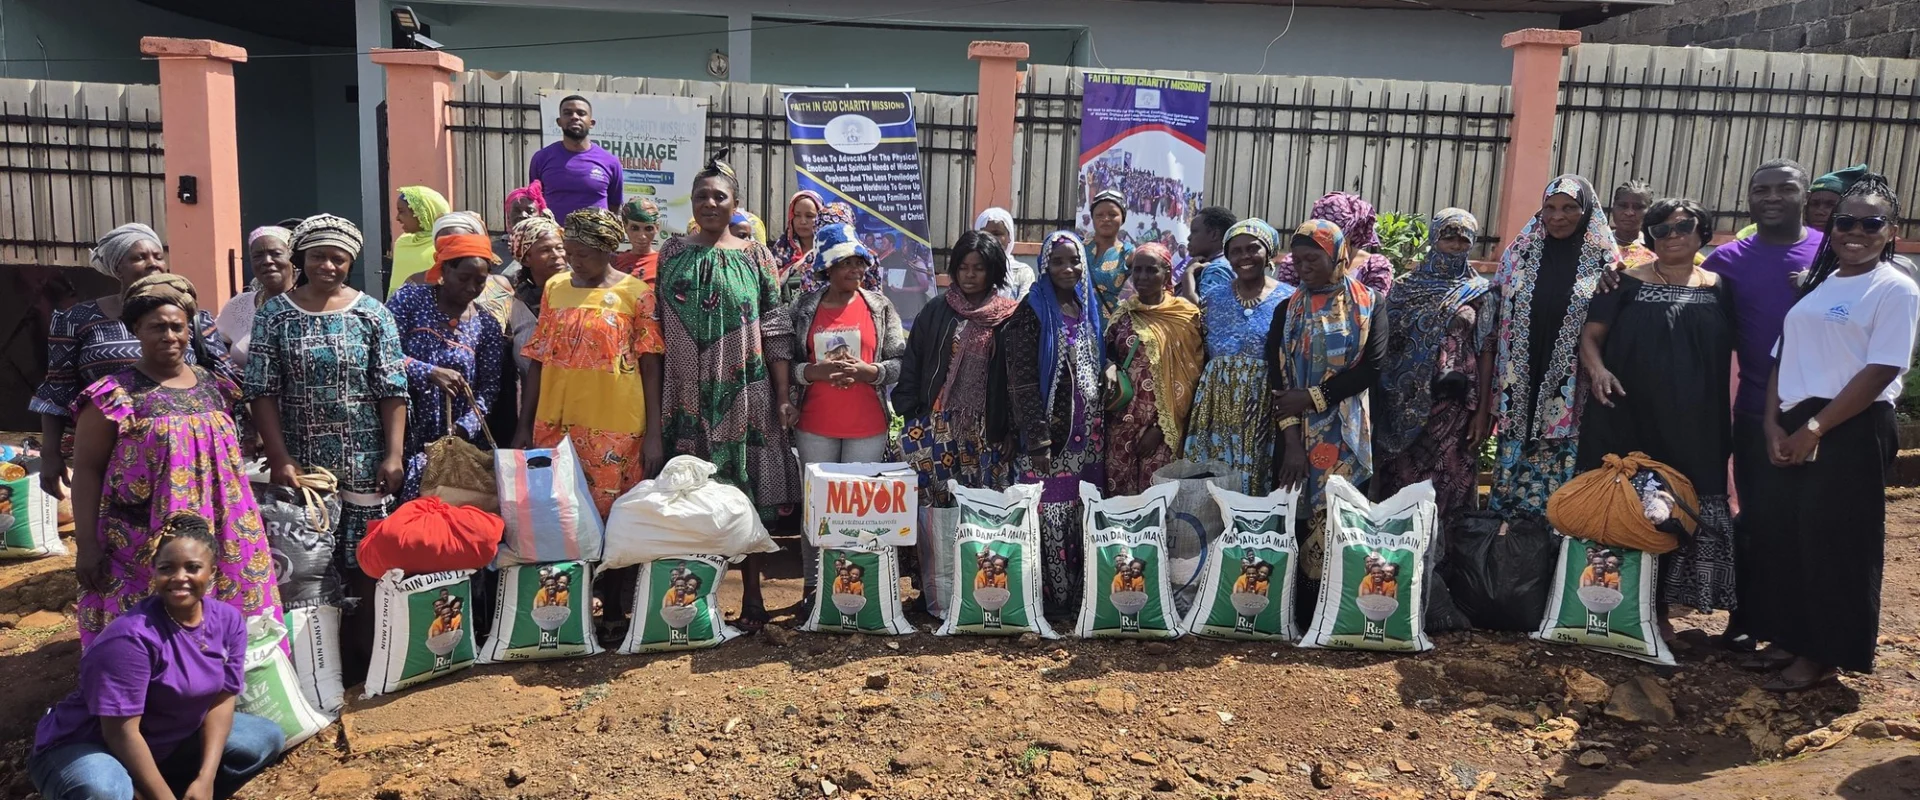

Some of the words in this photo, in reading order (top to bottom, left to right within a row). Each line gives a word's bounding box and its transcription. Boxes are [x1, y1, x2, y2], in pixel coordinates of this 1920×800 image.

[1088, 74, 1110, 83] FAITH
[1112, 75, 1120, 84] IN
[1122, 76, 1136, 86] GOD
[1137, 76, 1169, 88] CHARITY
[1171, 80, 1206, 92] MISSIONS
[790, 102, 811, 112] FAITH
[813, 101, 820, 111] IN
[822, 100, 837, 112] GOD
[839, 100, 870, 112] CHARITY
[871, 101, 905, 111] MISSIONS
[591, 139, 677, 161] PHANAGE
[838, 154, 867, 162] Advocate
[892, 153, 917, 162] Physical
[621, 157, 662, 169] HELINAT
[848, 164, 871, 173] Spiritual
[825, 174, 849, 184] Orphans
[874, 173, 887, 182] Less
[840, 184, 862, 192] Children
[912, 183, 920, 191] Up
[868, 194, 886, 202] Loving
[878, 204, 894, 212] Know
[1262, 535, 1271, 544] LA
[1336, 531, 1357, 544] MAIN
[1384, 537, 1395, 547] LA
[1398, 536, 1420, 549] MAIN
[426, 571, 452, 584] DANS
[313, 615, 319, 624] LA
[382, 619, 387, 627] LA
[1589, 614, 1607, 628] Riz
[1366, 621, 1384, 633] Riz
[1557, 633, 1578, 643] 25kg
